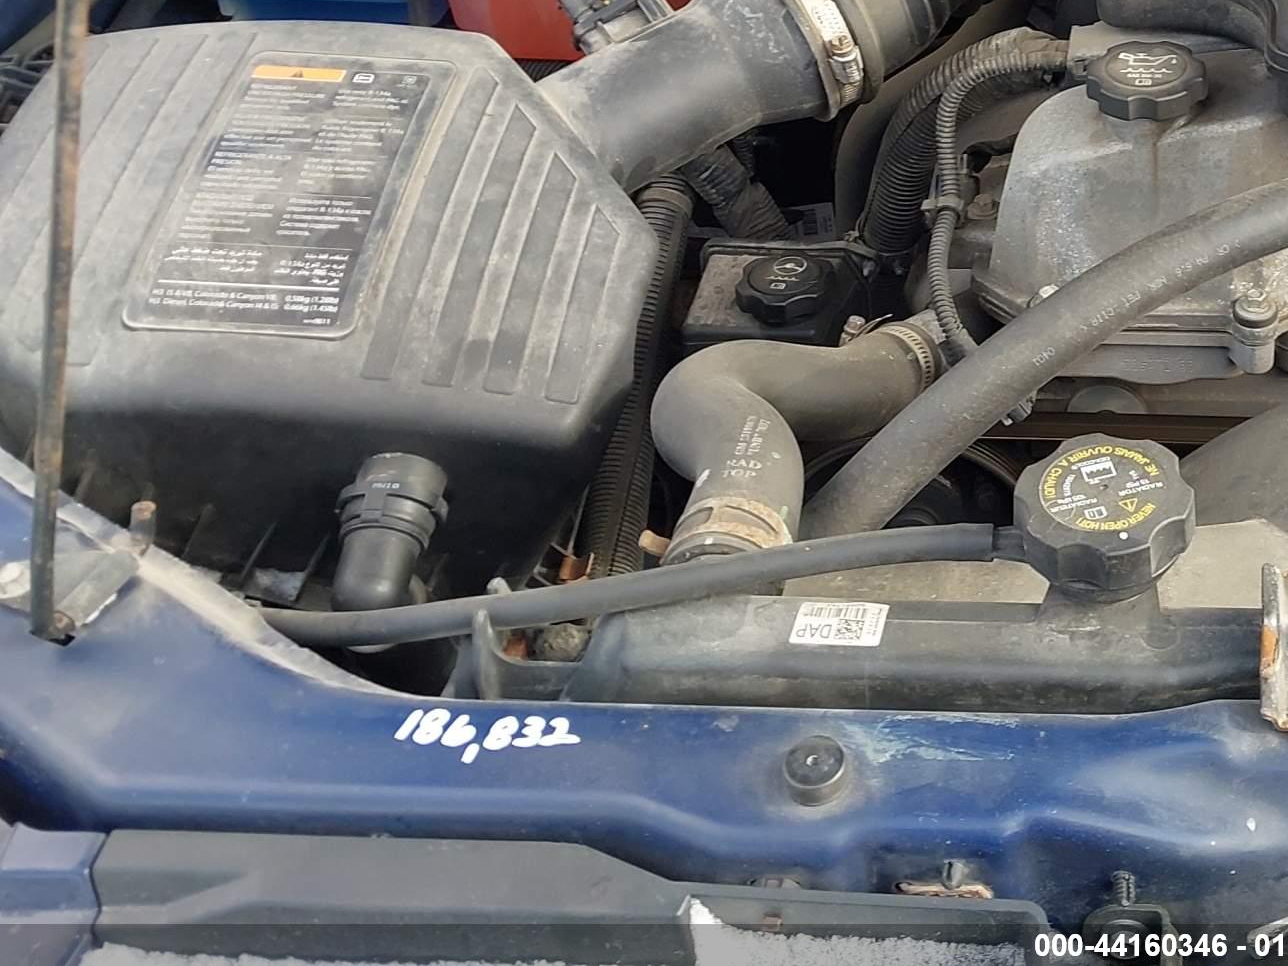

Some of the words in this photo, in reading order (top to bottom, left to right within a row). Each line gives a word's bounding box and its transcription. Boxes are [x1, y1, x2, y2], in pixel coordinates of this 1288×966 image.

[1067, 445, 1113, 463] OUVRIR
[1114, 446, 1150, 467] JAMAIS
[726, 458, 763, 470] RAD
[1147, 462, 1160, 476] NE
[721, 469, 758, 478] TOP
[1117, 480, 1164, 497] RADIATOR
[1048, 497, 1098, 513] RADIATEUR
[1126, 502, 1157, 525] NEVER
[1100, 518, 1129, 531] OPEN
[796, 623, 833, 639] DAP
